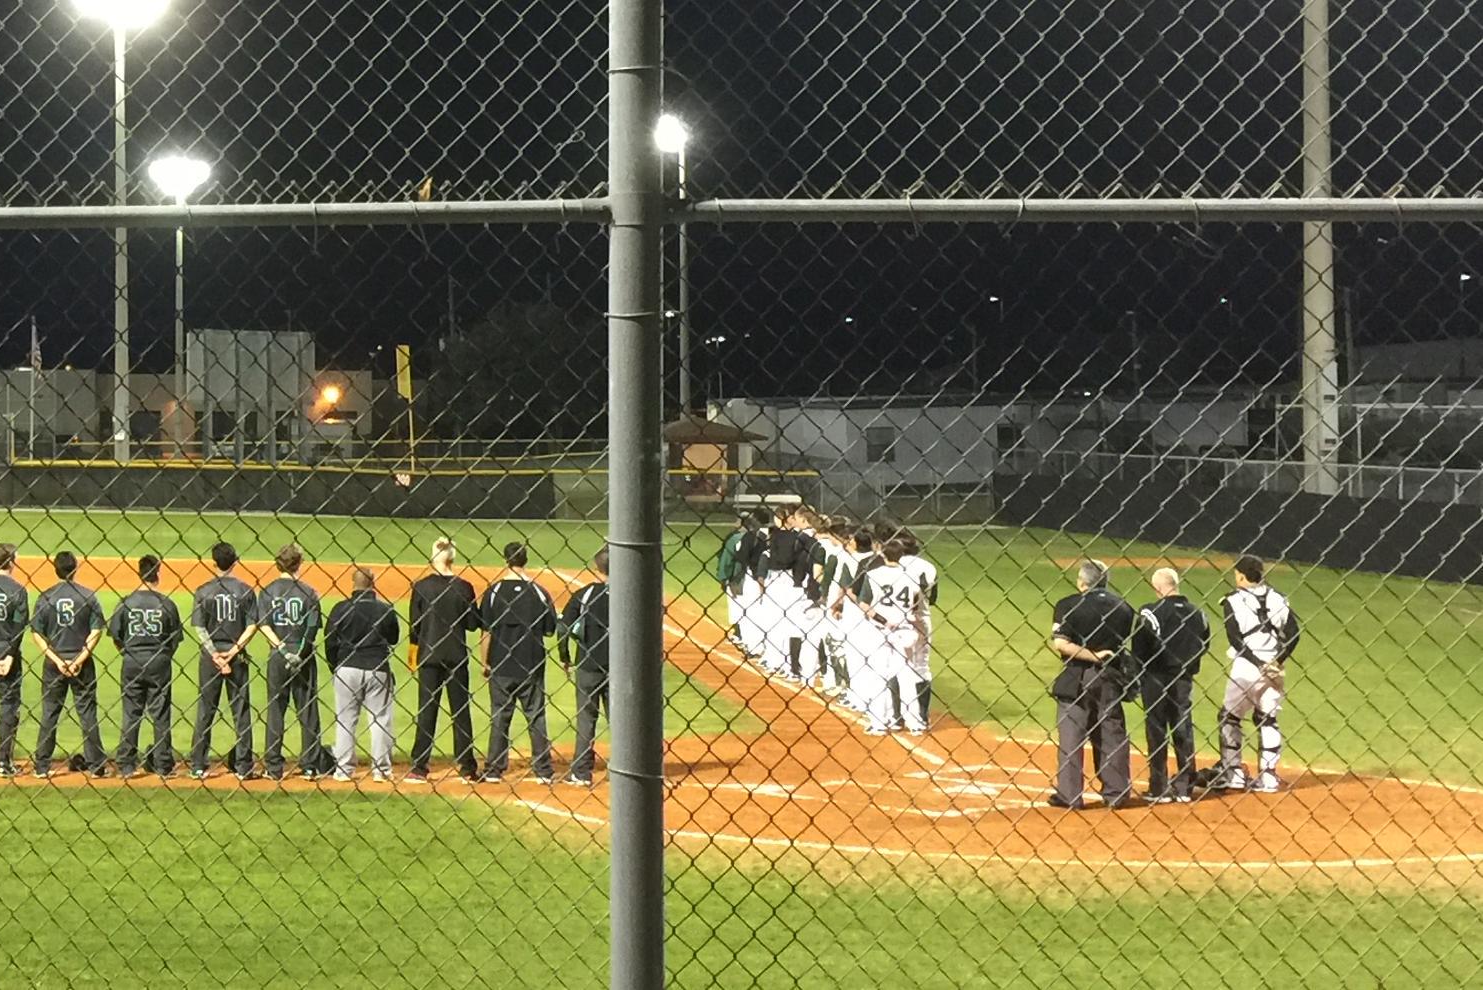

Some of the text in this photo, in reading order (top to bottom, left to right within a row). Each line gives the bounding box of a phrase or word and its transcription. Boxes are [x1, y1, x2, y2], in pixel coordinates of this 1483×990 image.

[880, 584, 910, 608] 24
[56, 598, 75, 627] 6
[128, 608, 163, 637] 25
[272, 597, 304, 626] 20
